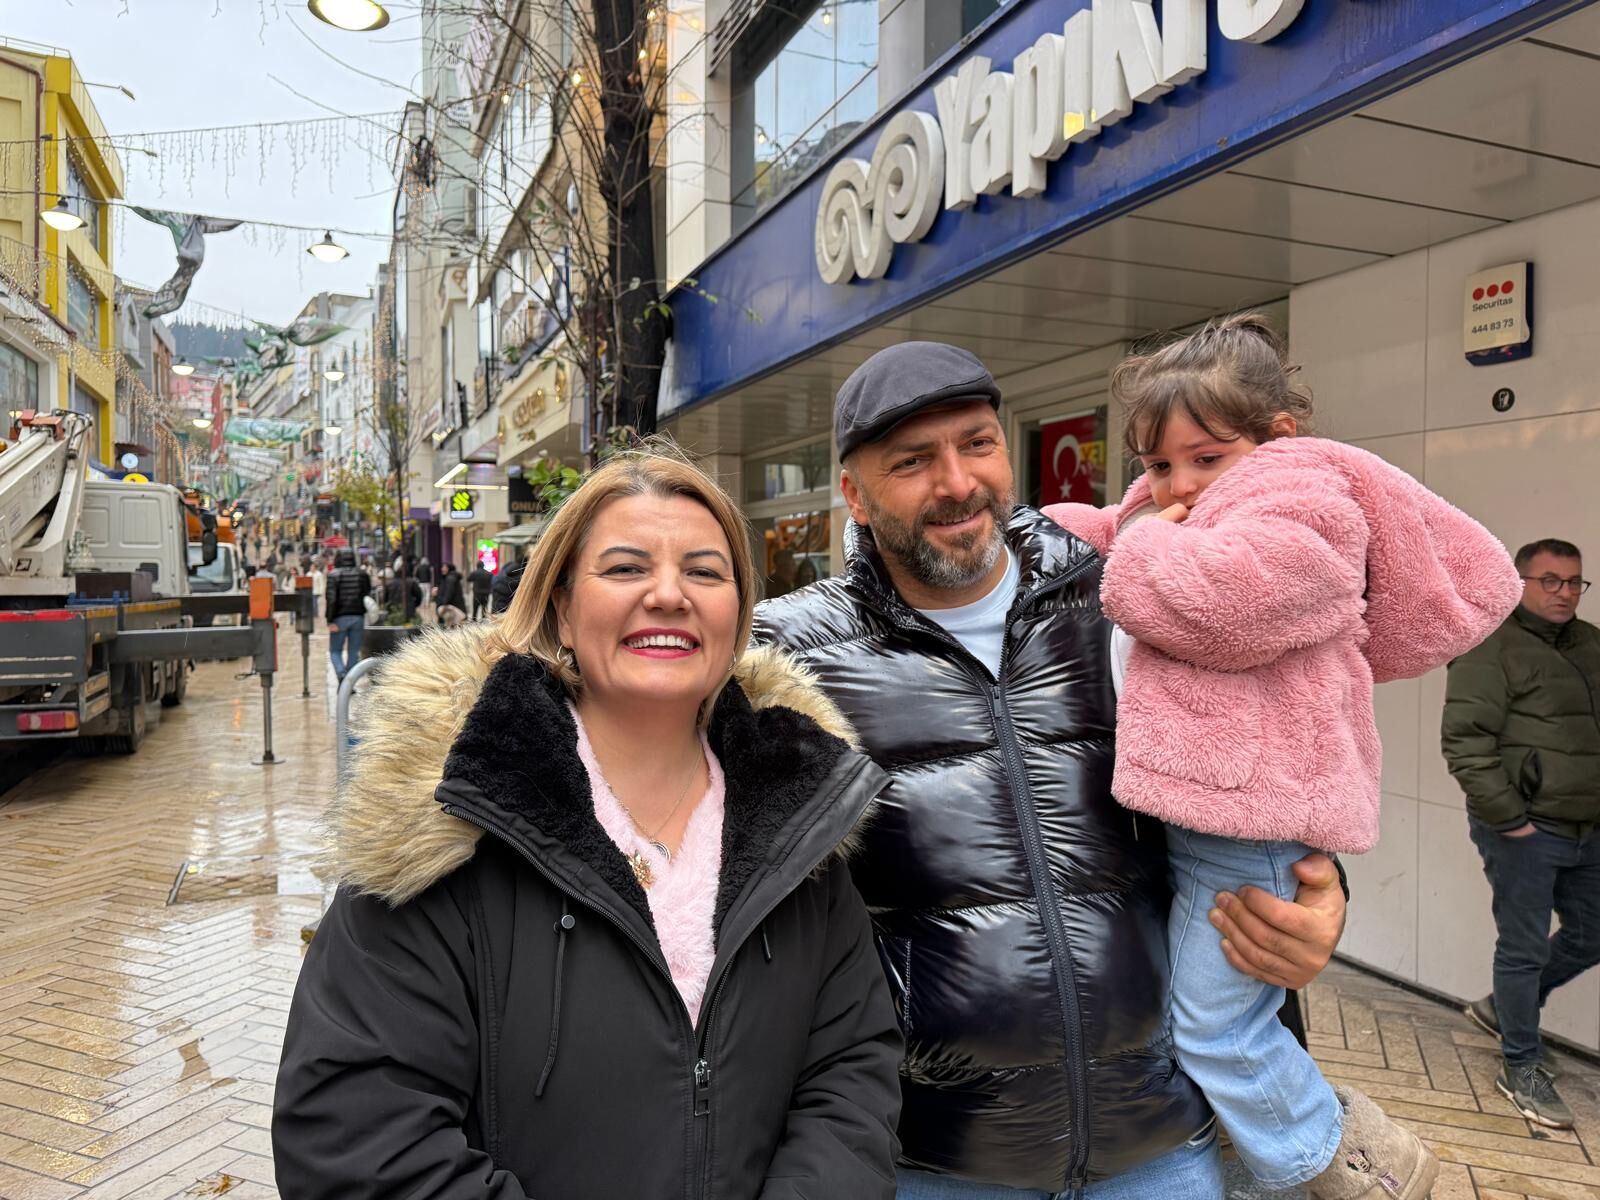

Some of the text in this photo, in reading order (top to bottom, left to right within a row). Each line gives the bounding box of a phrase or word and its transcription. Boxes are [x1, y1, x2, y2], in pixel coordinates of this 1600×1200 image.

[1472, 297, 1513, 312] Securitas
[1471, 318, 1514, 334] 444 83 73
